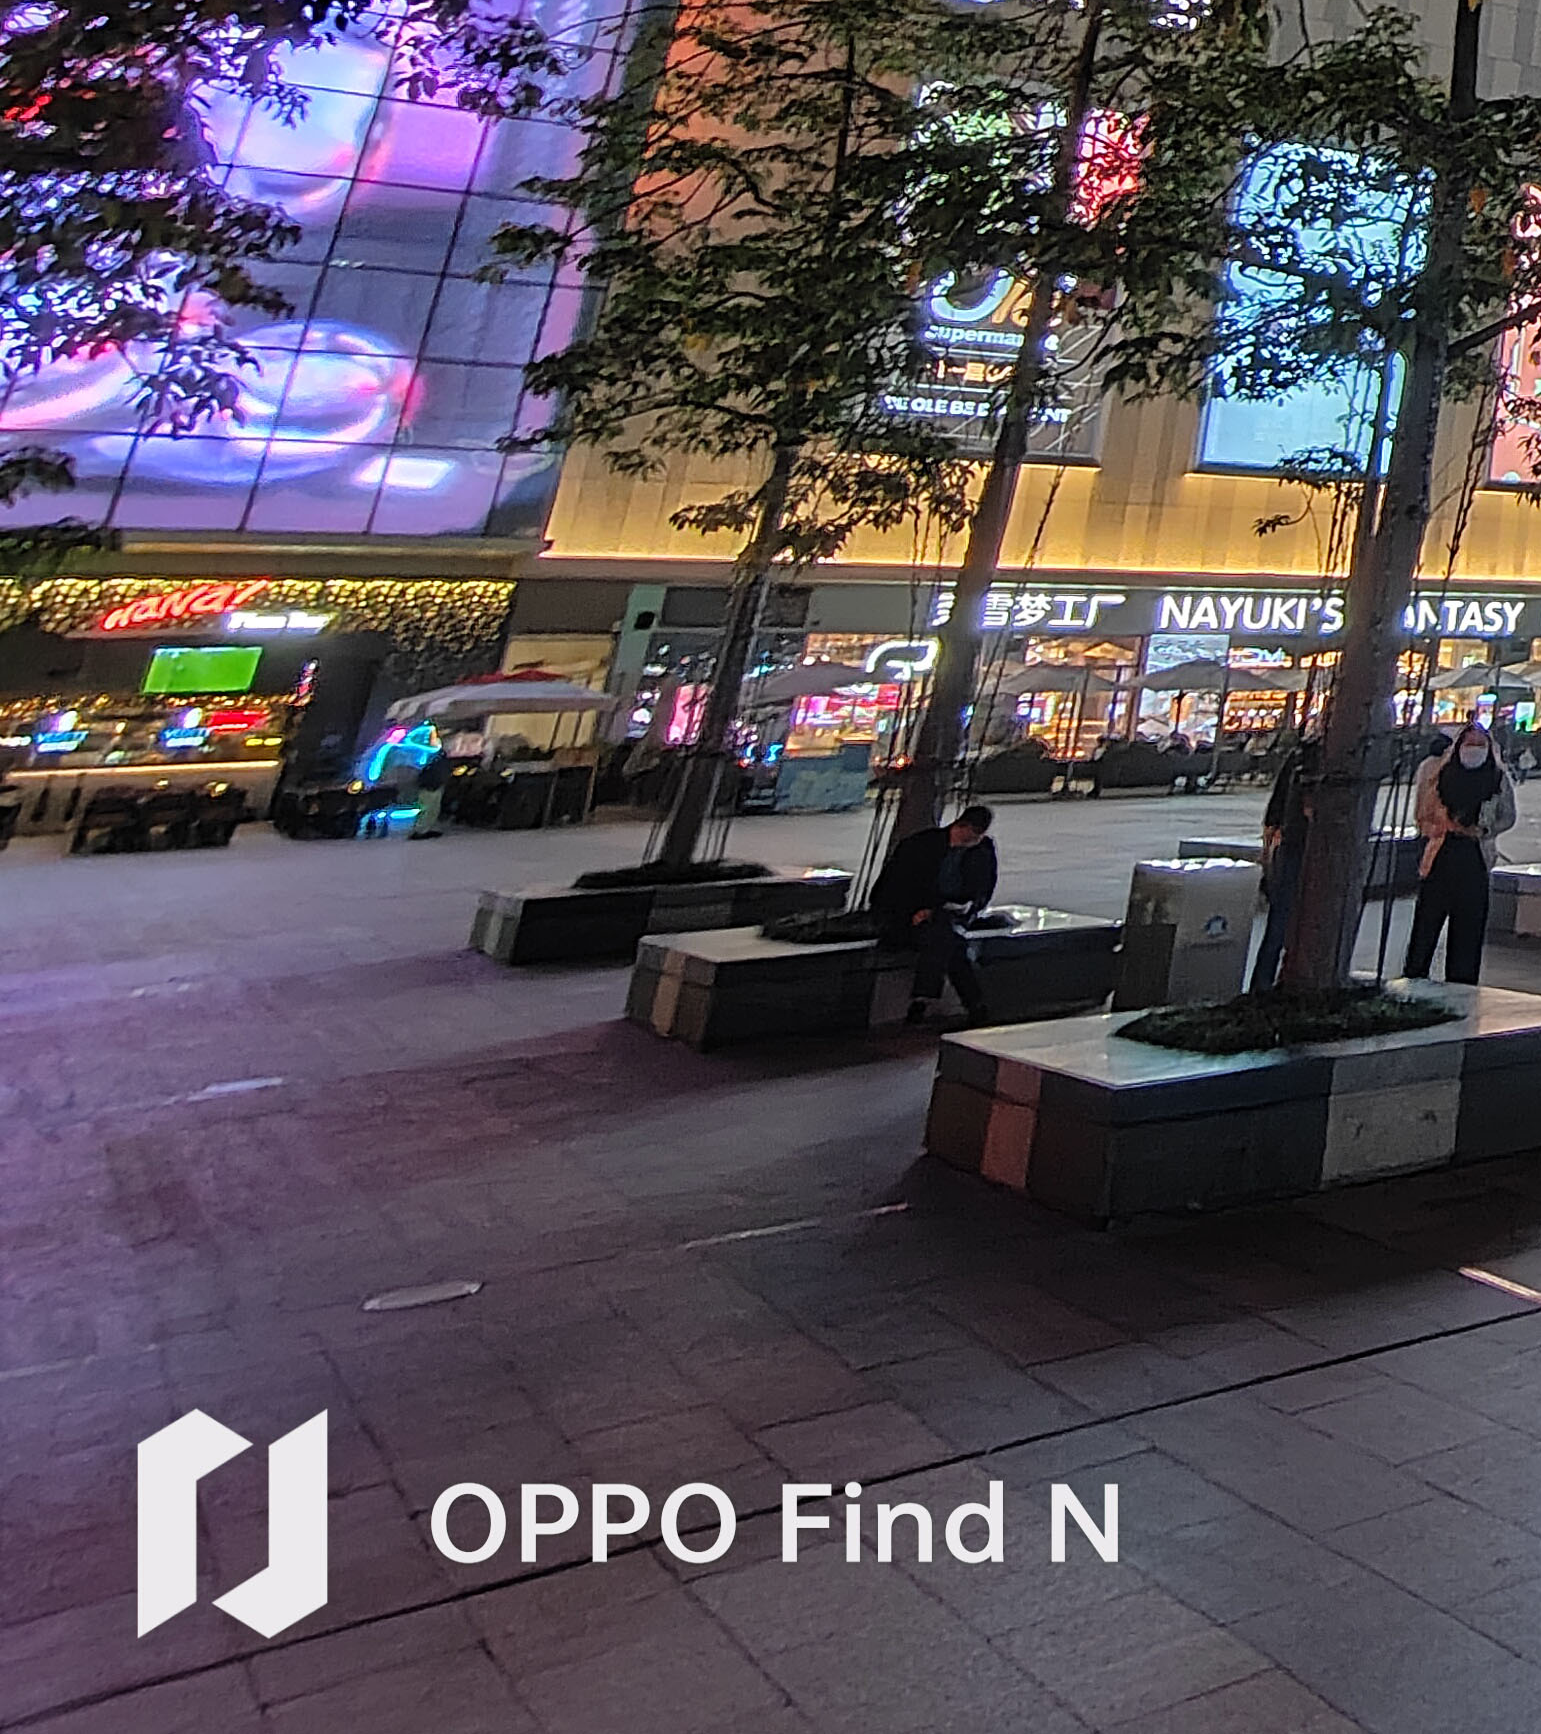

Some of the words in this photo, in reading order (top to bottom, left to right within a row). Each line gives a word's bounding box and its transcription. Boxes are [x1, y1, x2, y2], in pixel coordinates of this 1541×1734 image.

[930, 591, 1127, 630] 雪梦工厂
[1160, 594, 1345, 632] NAYUKI'S
[1403, 601, 1525, 633] NTASY
